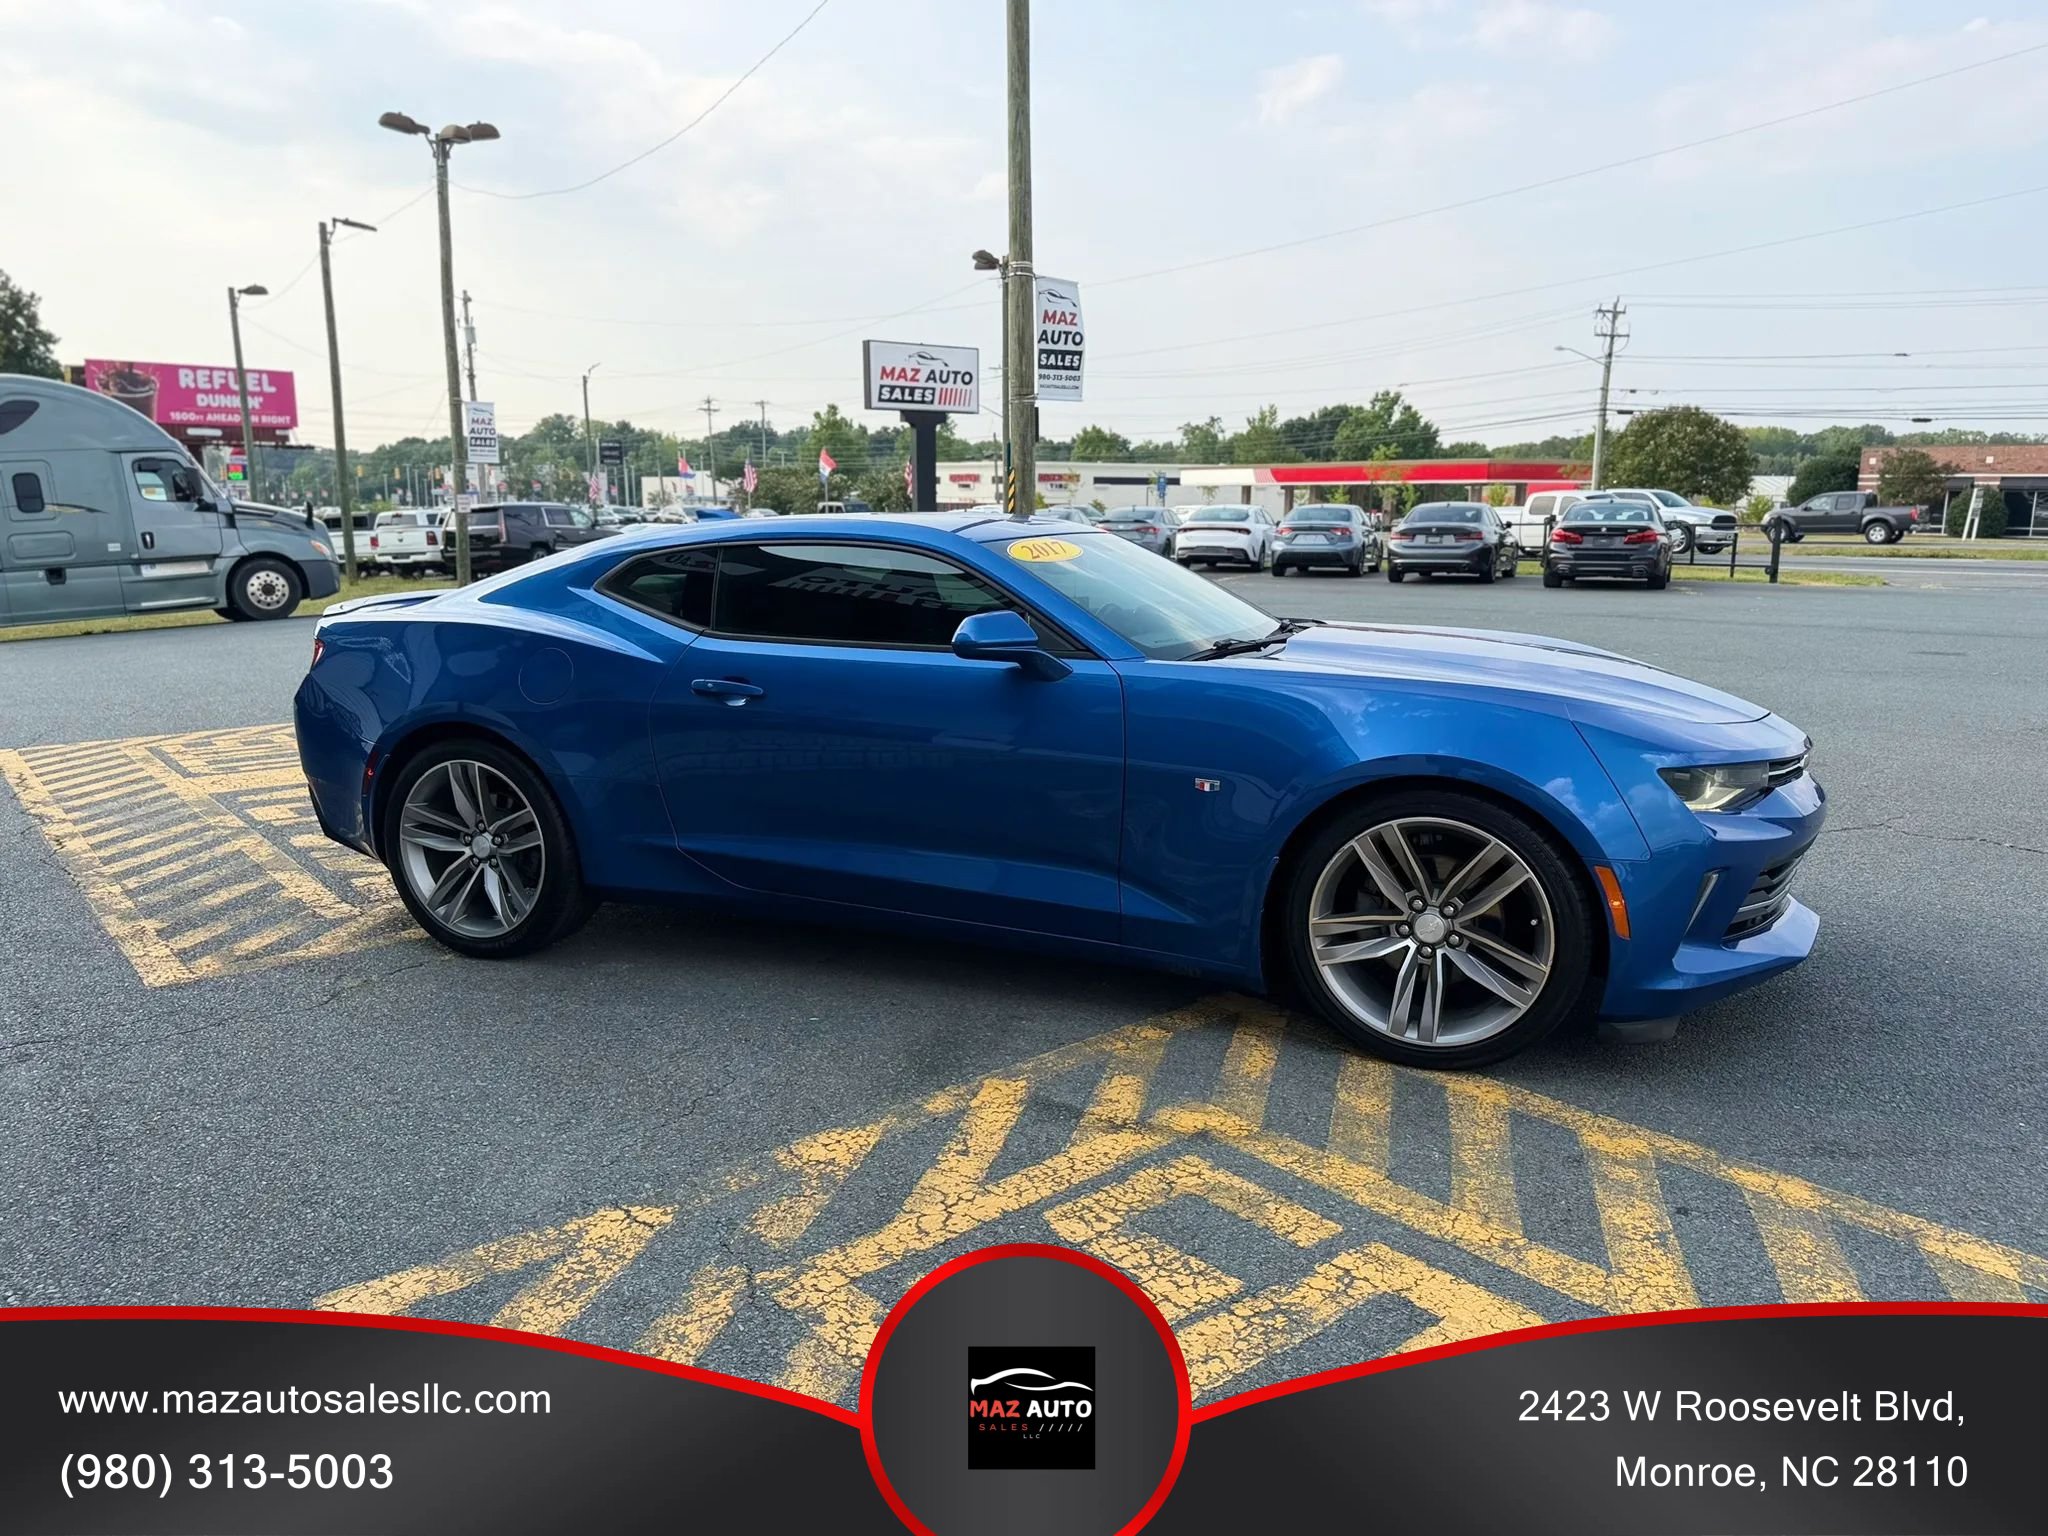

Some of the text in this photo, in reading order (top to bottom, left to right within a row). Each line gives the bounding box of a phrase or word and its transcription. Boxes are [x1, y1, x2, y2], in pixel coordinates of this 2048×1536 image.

[1042, 309, 1078, 327] MAZ
[1038, 329, 1084, 346] AUTO
[1040, 353, 1080, 367] SALES
[880, 366, 973, 385] MAZ AUTO
[196, 393, 264, 409] DUNKN'
[880, 386, 934, 402] SALES
[206, 413, 241, 422] AHEAD
[261, 415, 291, 425] RIGHT
[471, 417, 493, 425] MAZ
[469, 427, 496, 435] AUTO
[471, 438, 496, 446] SALES
[1020, 541, 1067, 560] 2017
